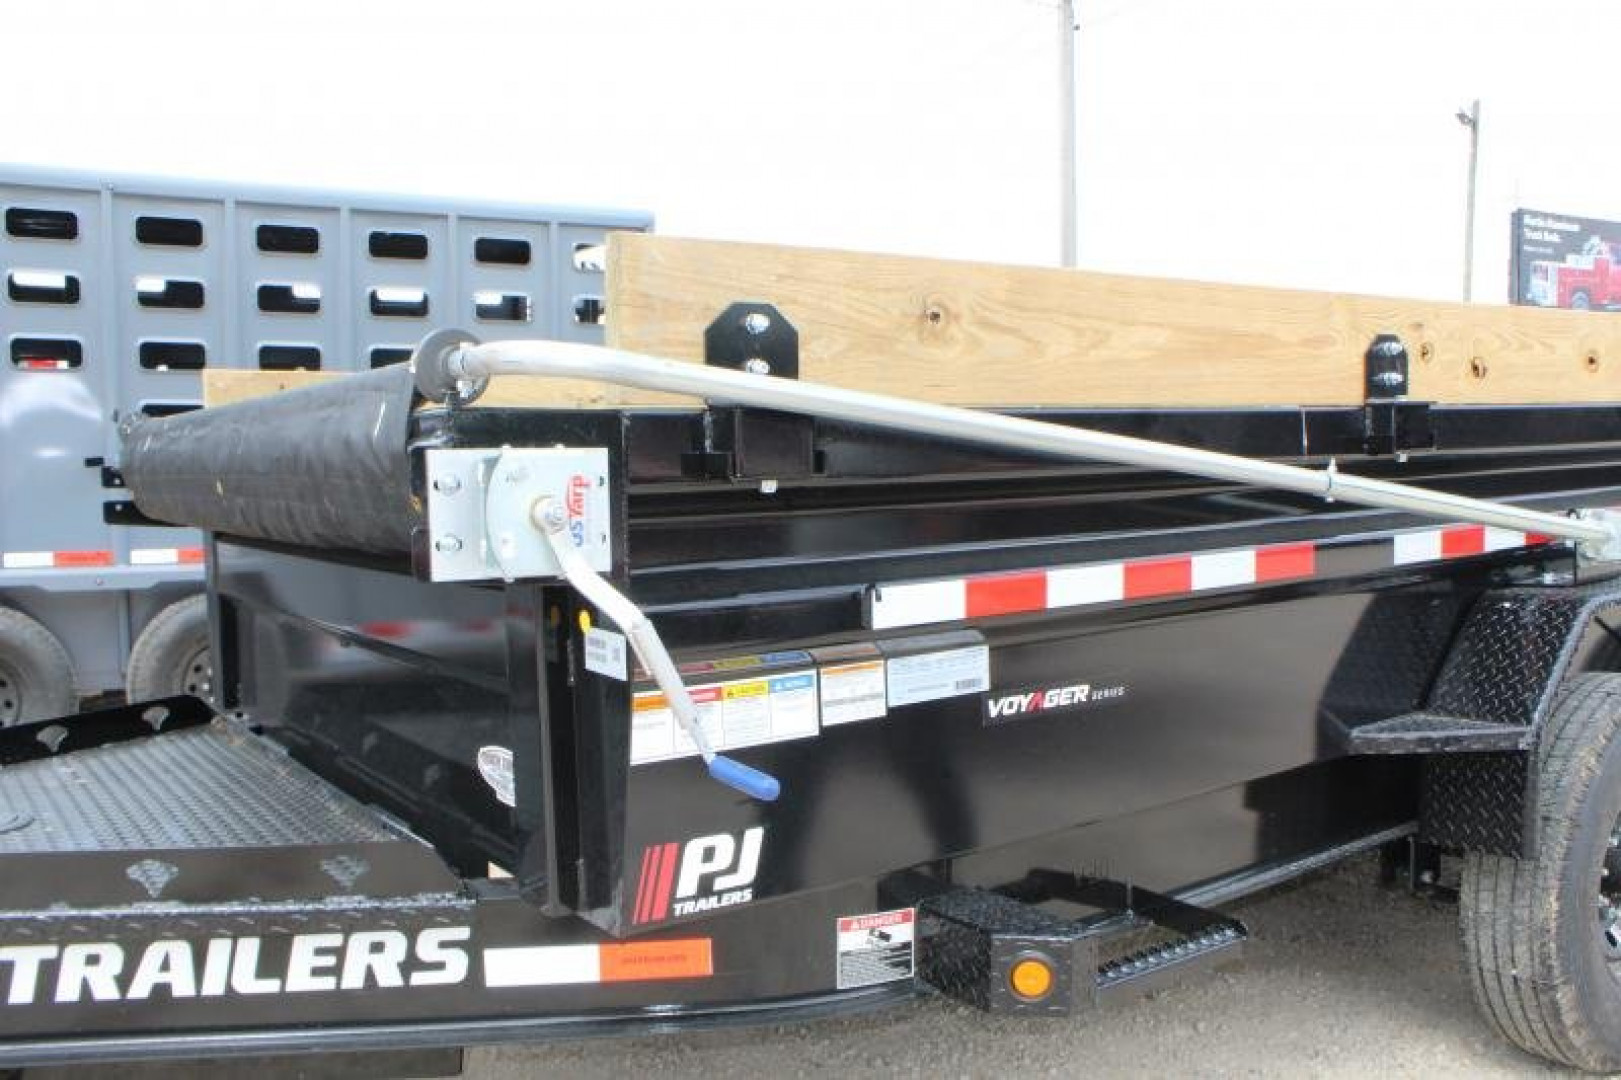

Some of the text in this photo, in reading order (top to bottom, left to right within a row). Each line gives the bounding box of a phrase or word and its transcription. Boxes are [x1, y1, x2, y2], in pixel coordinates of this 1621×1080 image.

[565, 474, 591, 518] Tarp
[988, 685, 1090, 718] VOYAGER
[676, 826, 764, 899] PJ
[672, 888, 753, 917] TRAILERS
[0, 927, 471, 1004] TRAILERS
